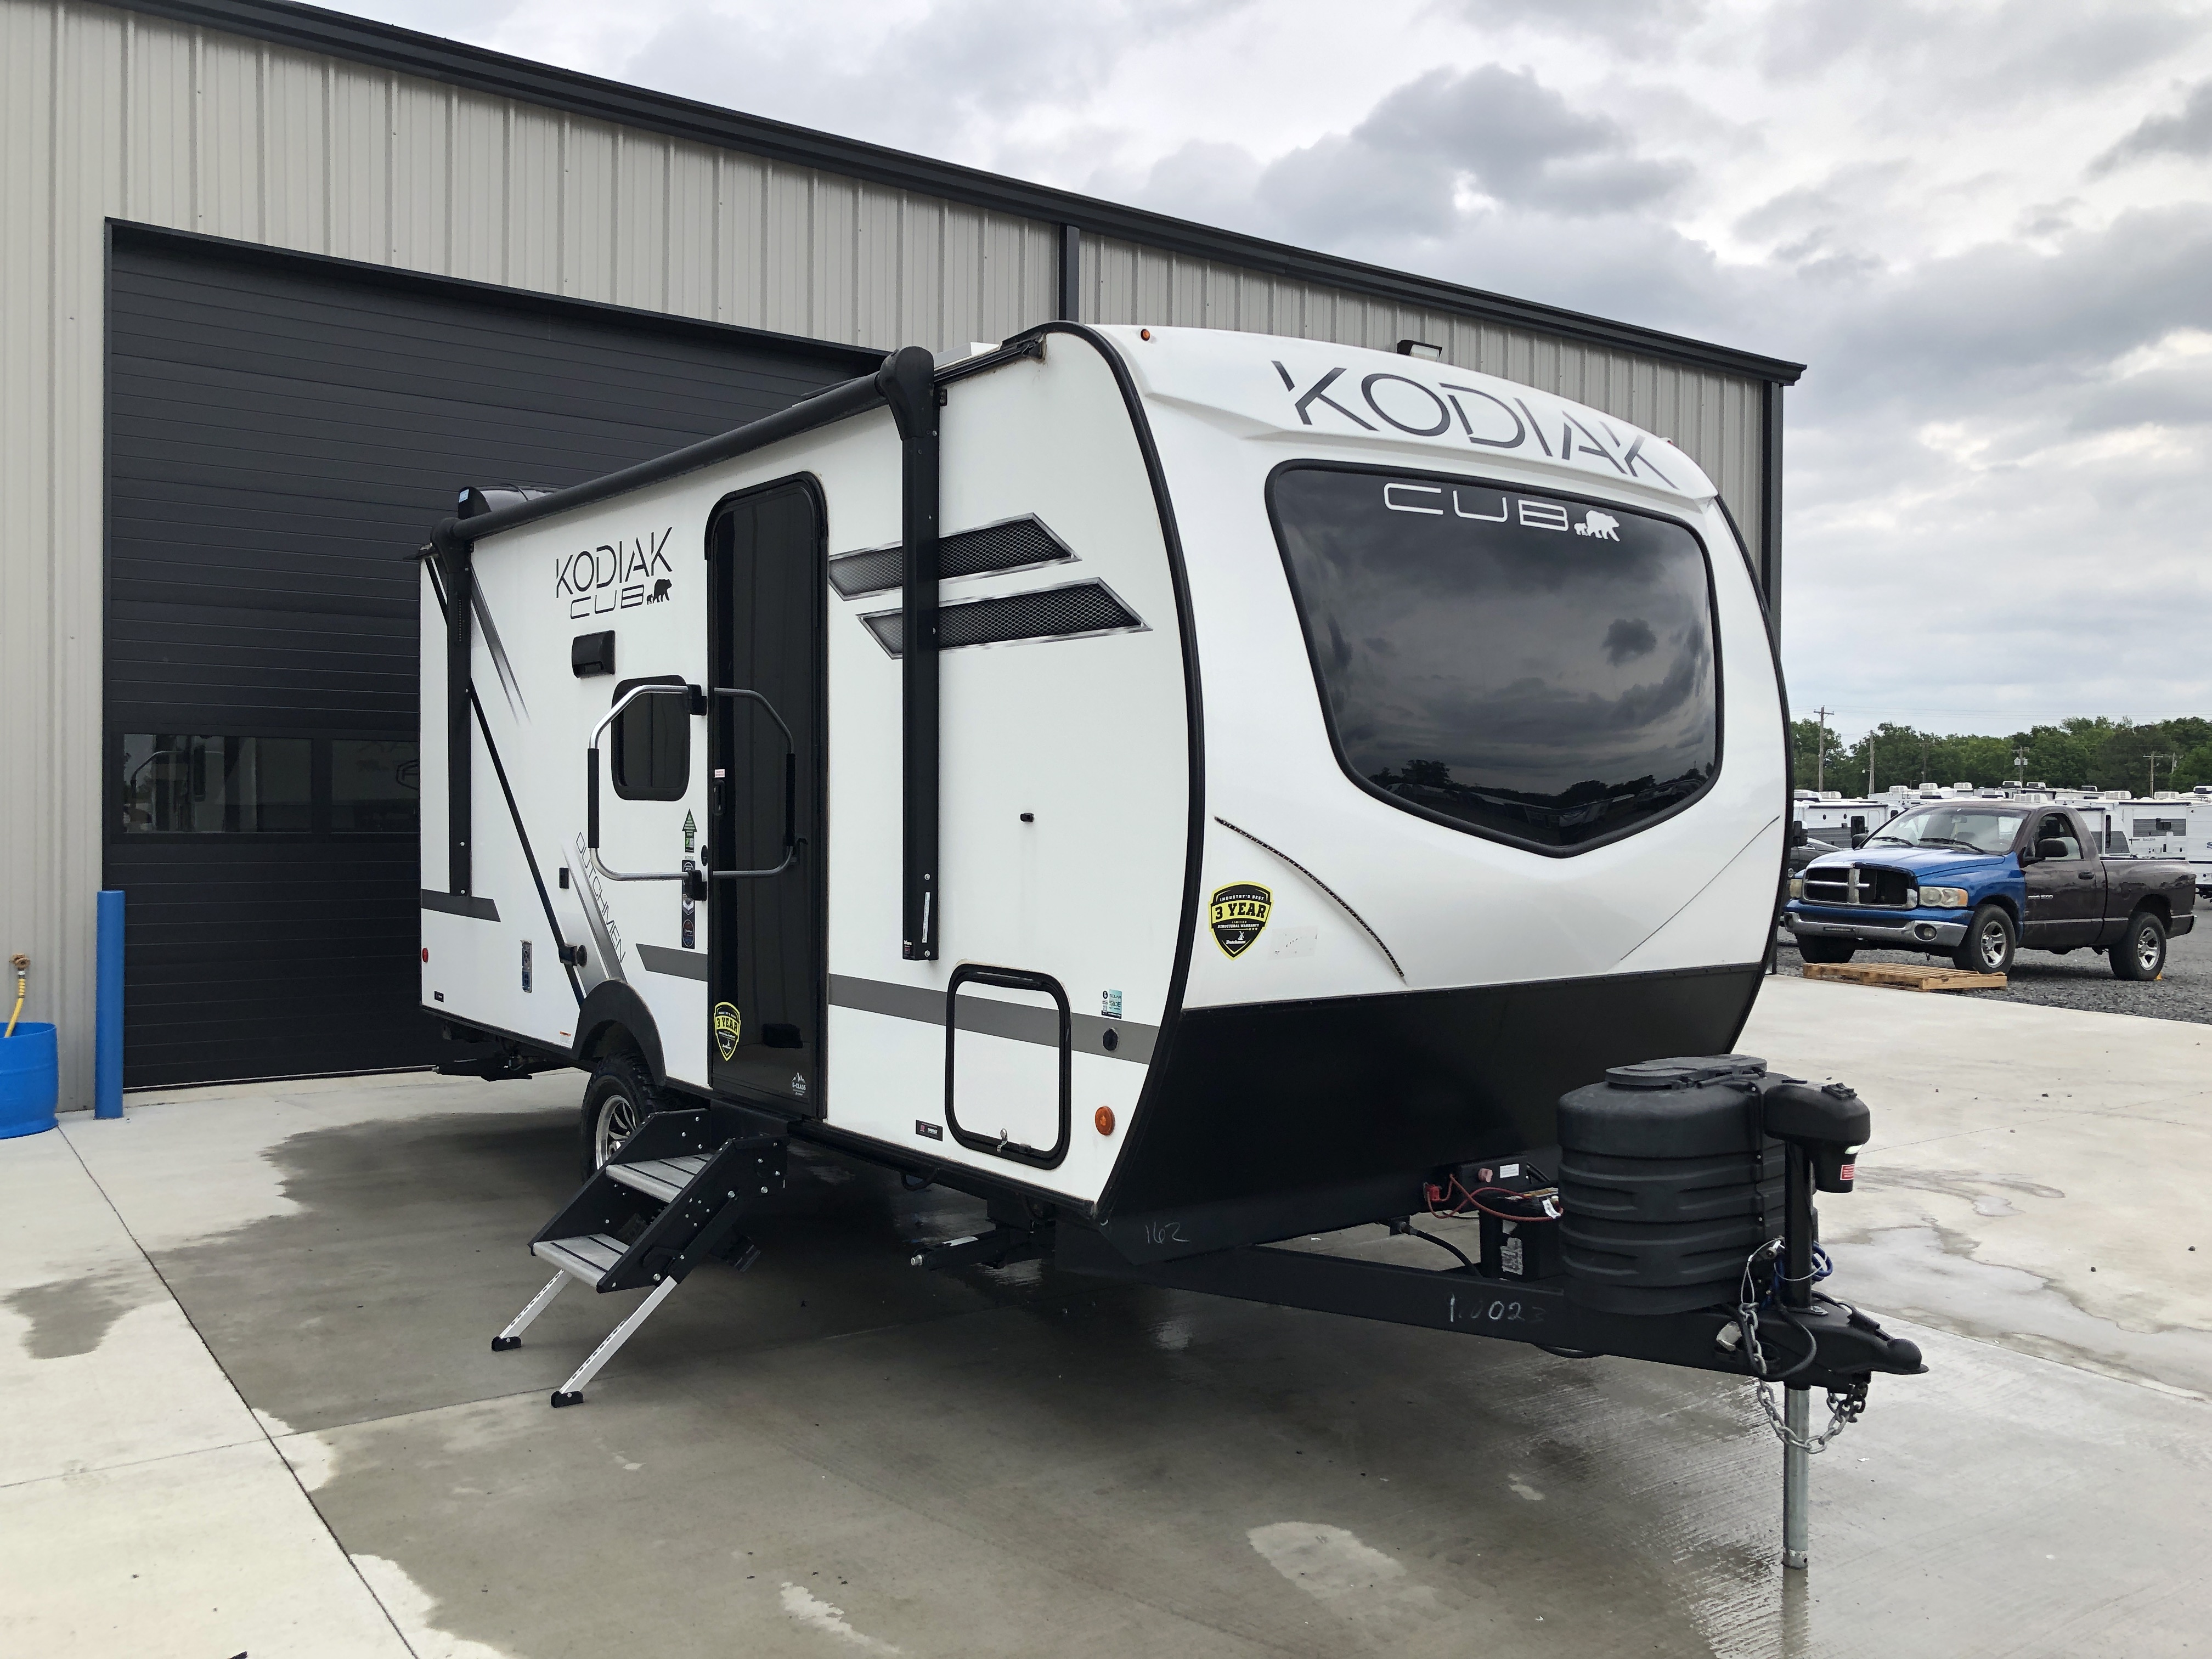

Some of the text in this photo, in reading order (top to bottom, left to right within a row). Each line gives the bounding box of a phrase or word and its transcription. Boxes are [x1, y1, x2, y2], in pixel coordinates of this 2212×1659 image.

[1271, 360, 1680, 490] KODIAK
[1383, 482, 1569, 532] CUB
[556, 526, 673, 599] KODIAK
[570, 584, 645, 619] CUB
[575, 831, 626, 963] DUTCHMEN
[1215, 902, 1266, 920] 3 YEAR
[716, 1017, 738, 1032] 3 YEAR
[1145, 1220, 1190, 1244] 162
